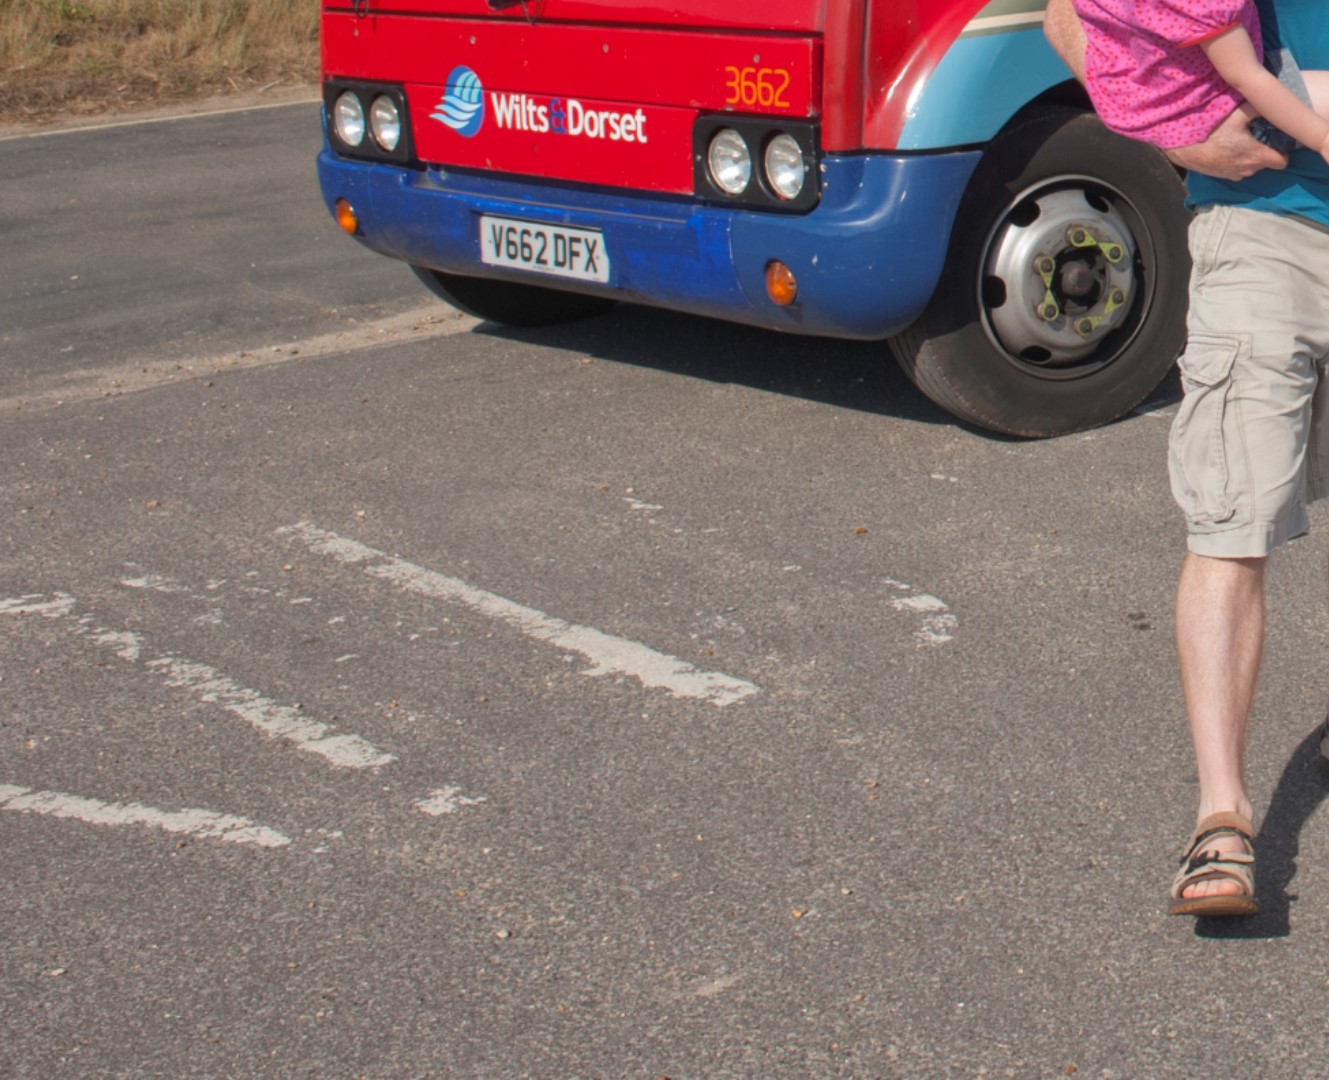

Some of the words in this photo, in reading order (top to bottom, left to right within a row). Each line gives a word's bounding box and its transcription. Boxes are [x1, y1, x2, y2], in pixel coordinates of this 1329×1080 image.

[725, 65, 790, 107] 3662
[566, 99, 647, 143] Dorset
[492, 224, 548, 265] V662
[553, 232, 598, 273] DFX
